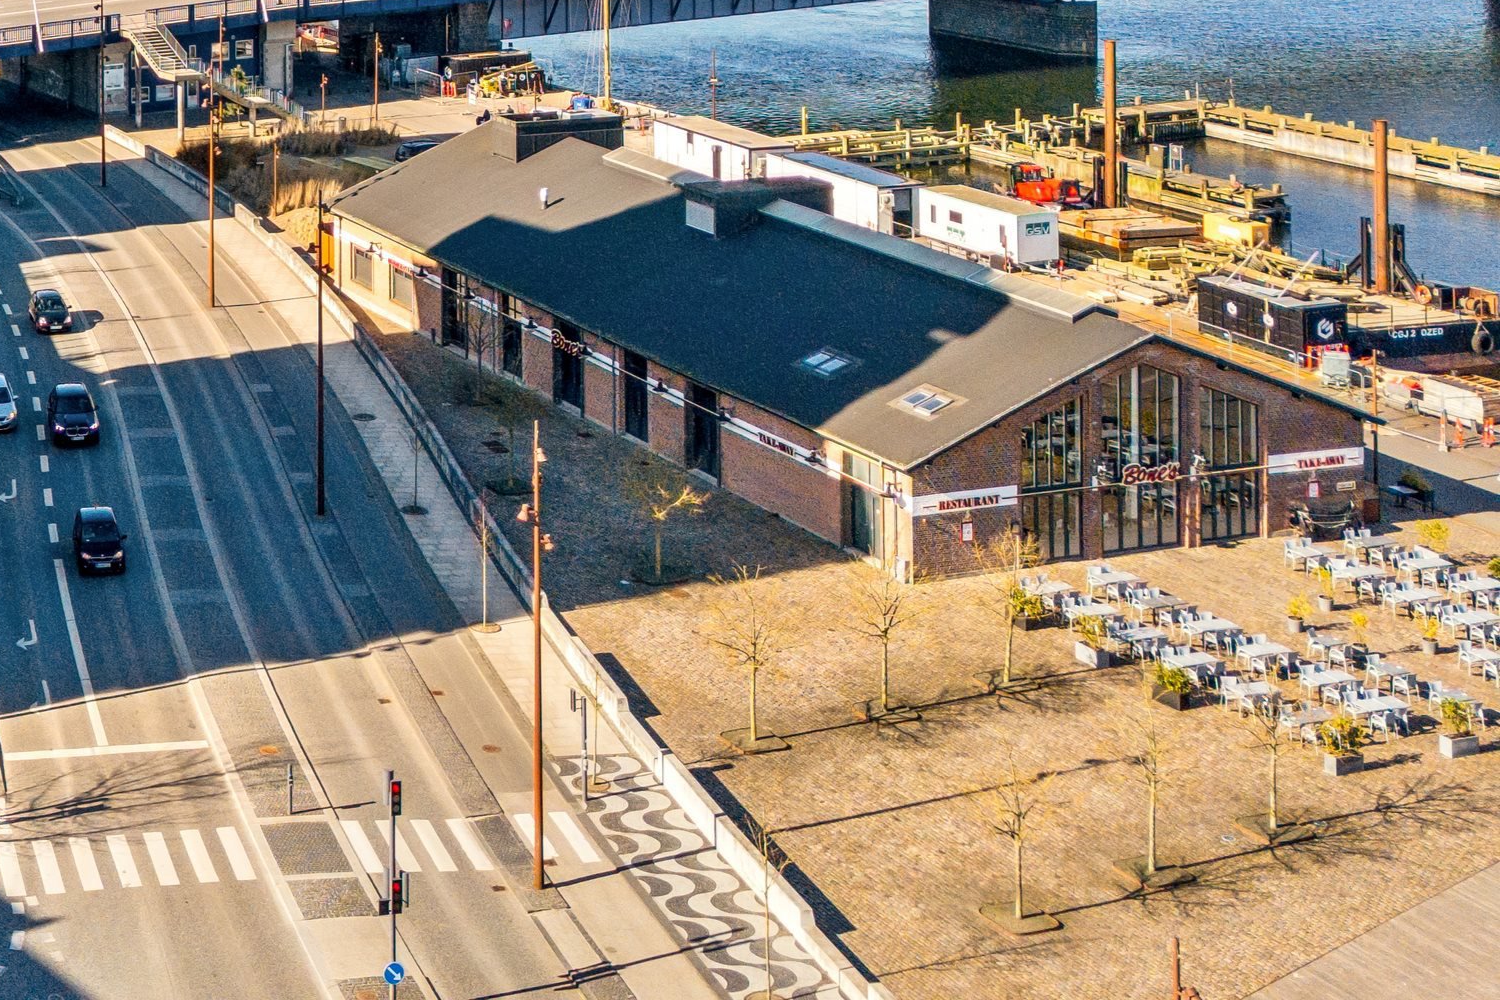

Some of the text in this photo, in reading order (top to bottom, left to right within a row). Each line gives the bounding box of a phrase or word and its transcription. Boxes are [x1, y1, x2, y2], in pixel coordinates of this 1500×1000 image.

[1026, 225, 1050, 236] GSV
[1410, 329, 1416, 338] 2
[757, 432, 795, 456] TAKE-AWAY
[1297, 454, 1346, 469] TAKE-AWAY
[1122, 462, 1180, 486] Bone's
[938, 494, 1000, 511] RESTAURANT
